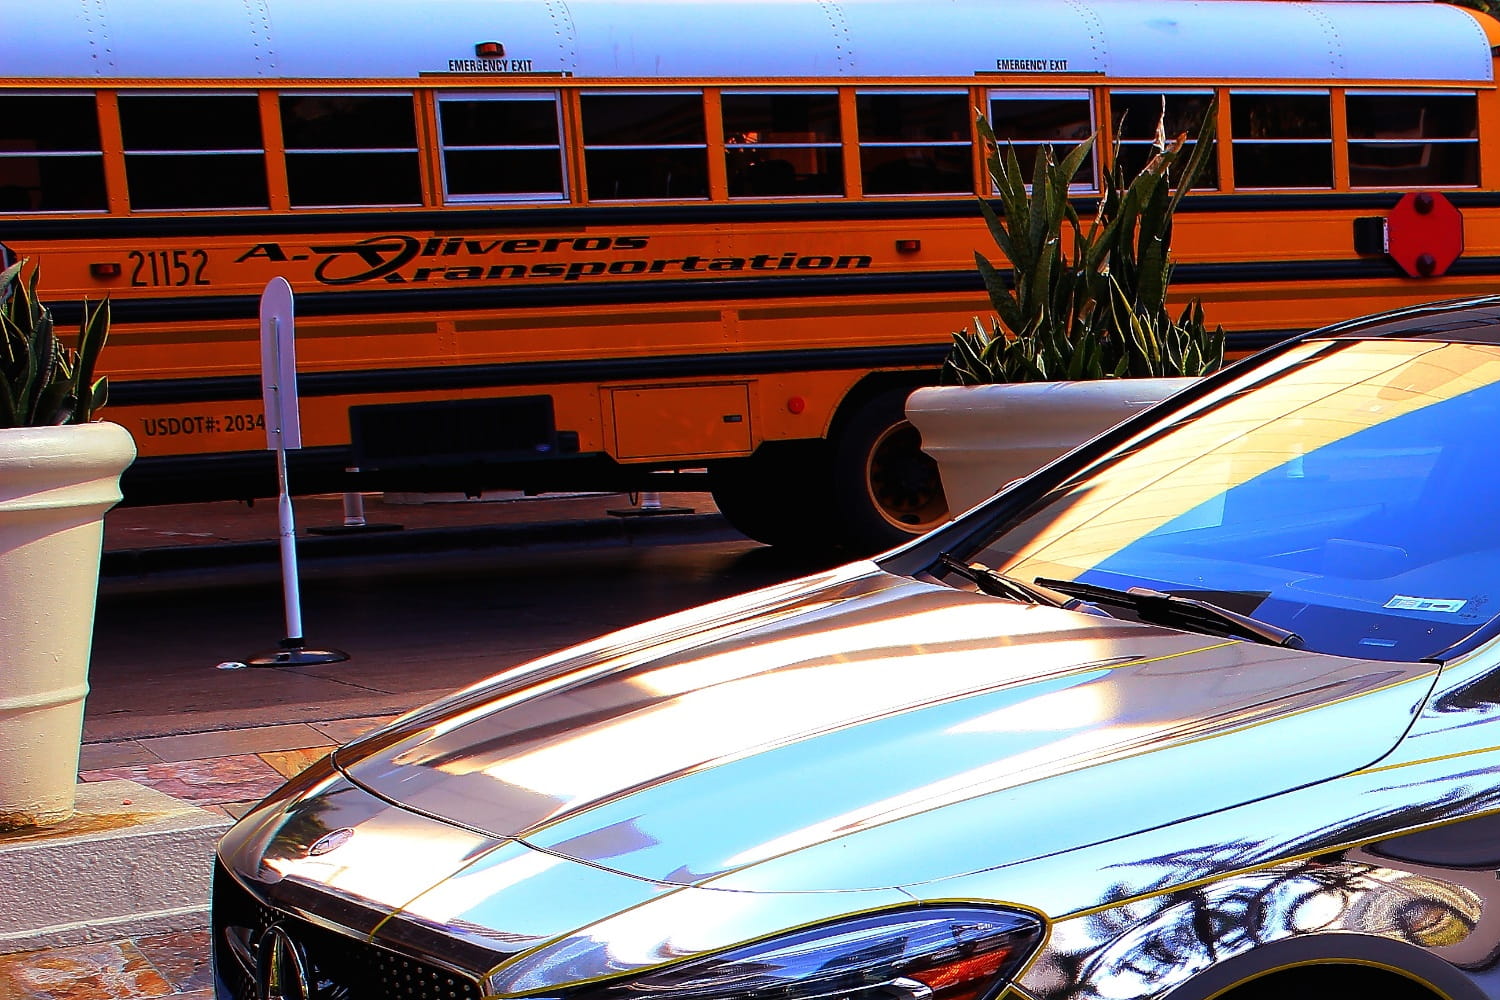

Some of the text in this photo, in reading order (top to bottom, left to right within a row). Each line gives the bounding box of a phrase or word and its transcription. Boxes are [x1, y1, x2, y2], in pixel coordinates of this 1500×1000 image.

[448, 59, 532, 72] EMERGENCY EXIT
[996, 59, 1068, 71] EMERGENCY EXIT
[129, 250, 211, 287] 21152
[142, 416, 221, 437] USDOT#:
